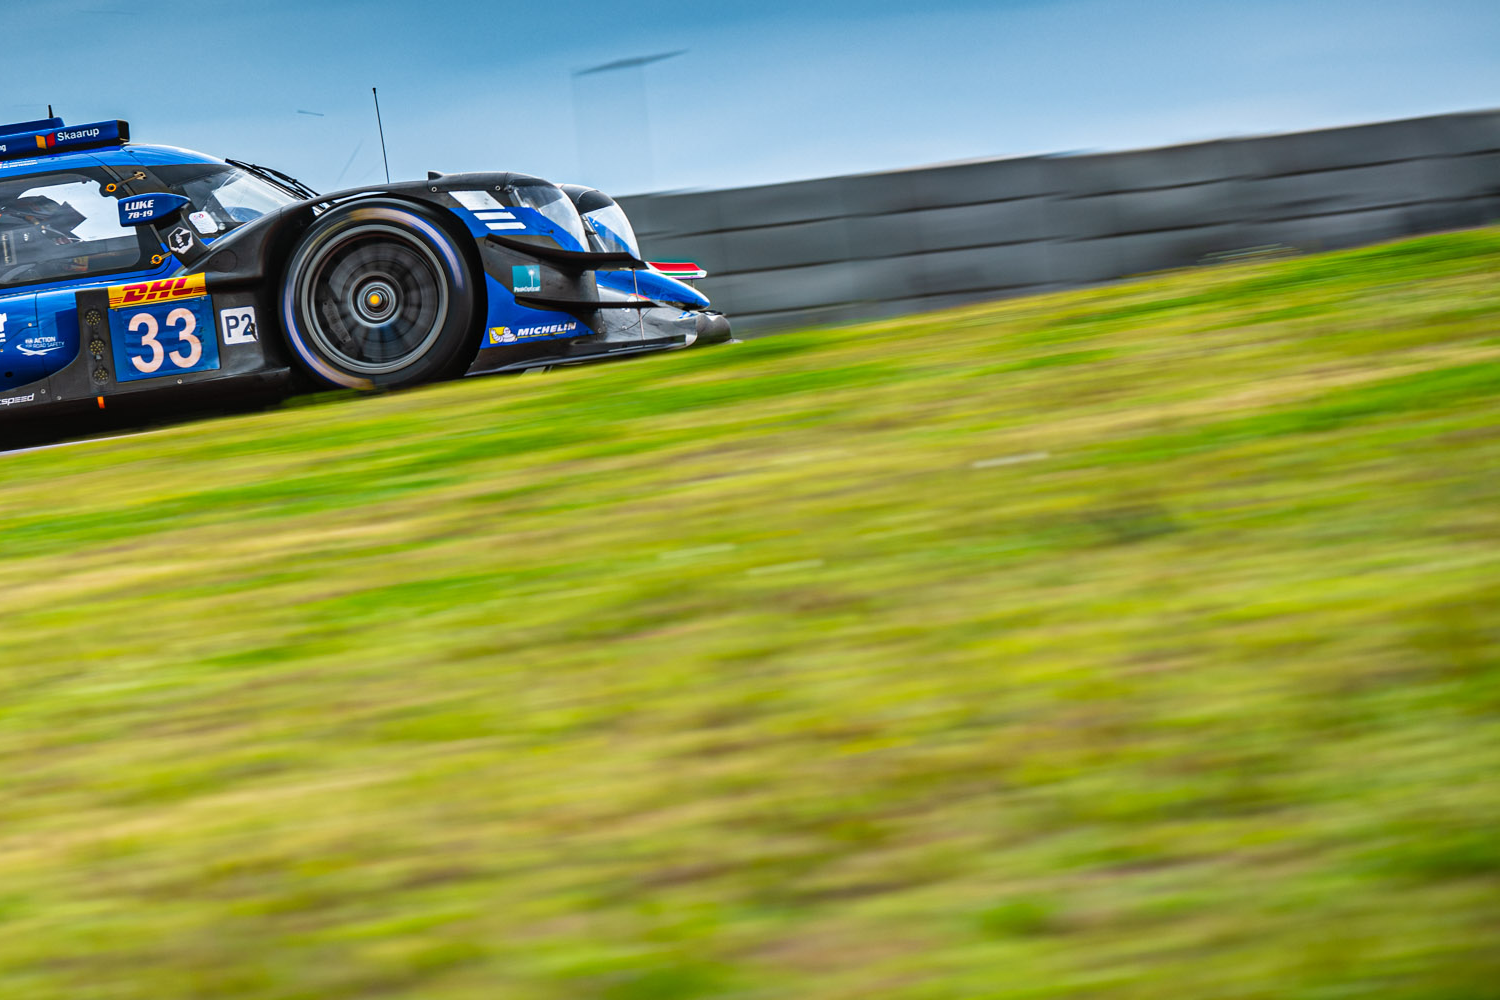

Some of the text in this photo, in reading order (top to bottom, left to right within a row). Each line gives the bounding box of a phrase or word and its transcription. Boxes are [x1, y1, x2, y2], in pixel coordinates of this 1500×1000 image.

[57, 128, 100, 142] Skaarup
[125, 199, 155, 211] LUKE
[128, 209, 154, 219] 78-19
[122, 278, 194, 303] DHL
[224, 313, 254, 339] P2
[517, 322, 577, 336] MICHELIN
[34, 336, 56, 344] ACTION
[128, 307, 203, 373] 33
